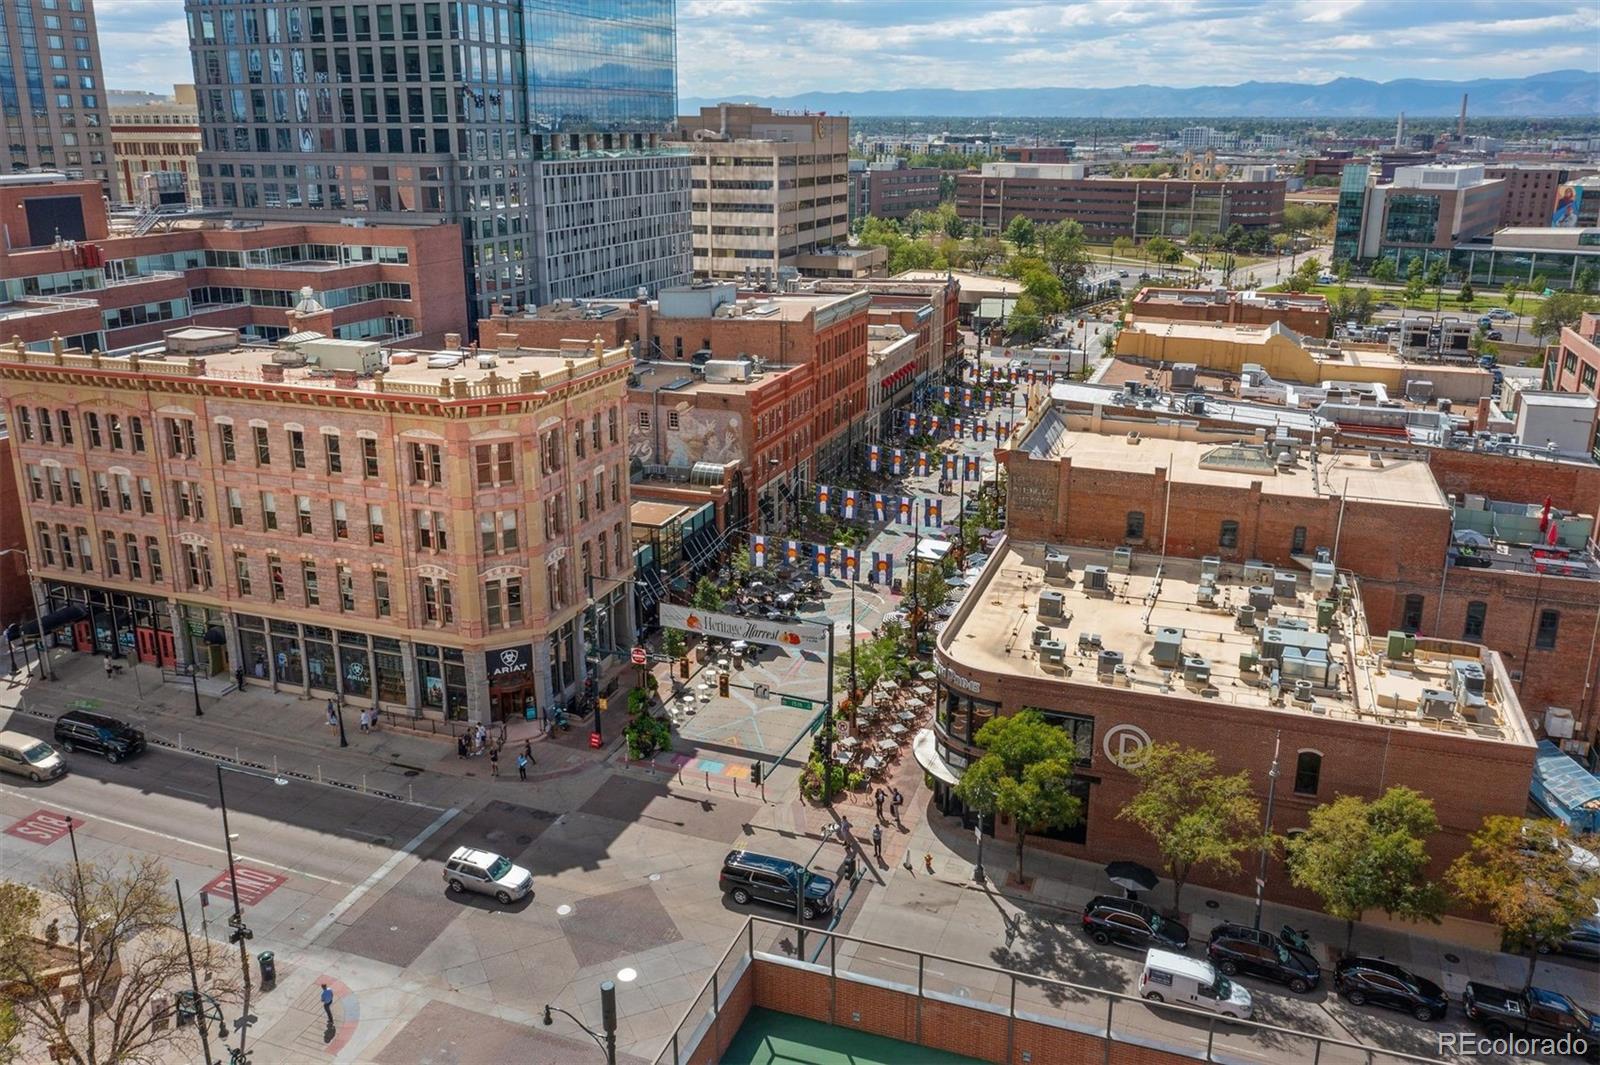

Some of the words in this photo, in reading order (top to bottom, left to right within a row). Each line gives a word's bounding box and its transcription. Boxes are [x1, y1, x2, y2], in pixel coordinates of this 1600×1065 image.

[704, 616, 742, 637] Heritage
[346, 674, 369, 683] ARIAT
[493, 663, 527, 676] ARIAT
[16, 814, 69, 839] BUS
[212, 869, 277, 902] ONLY
